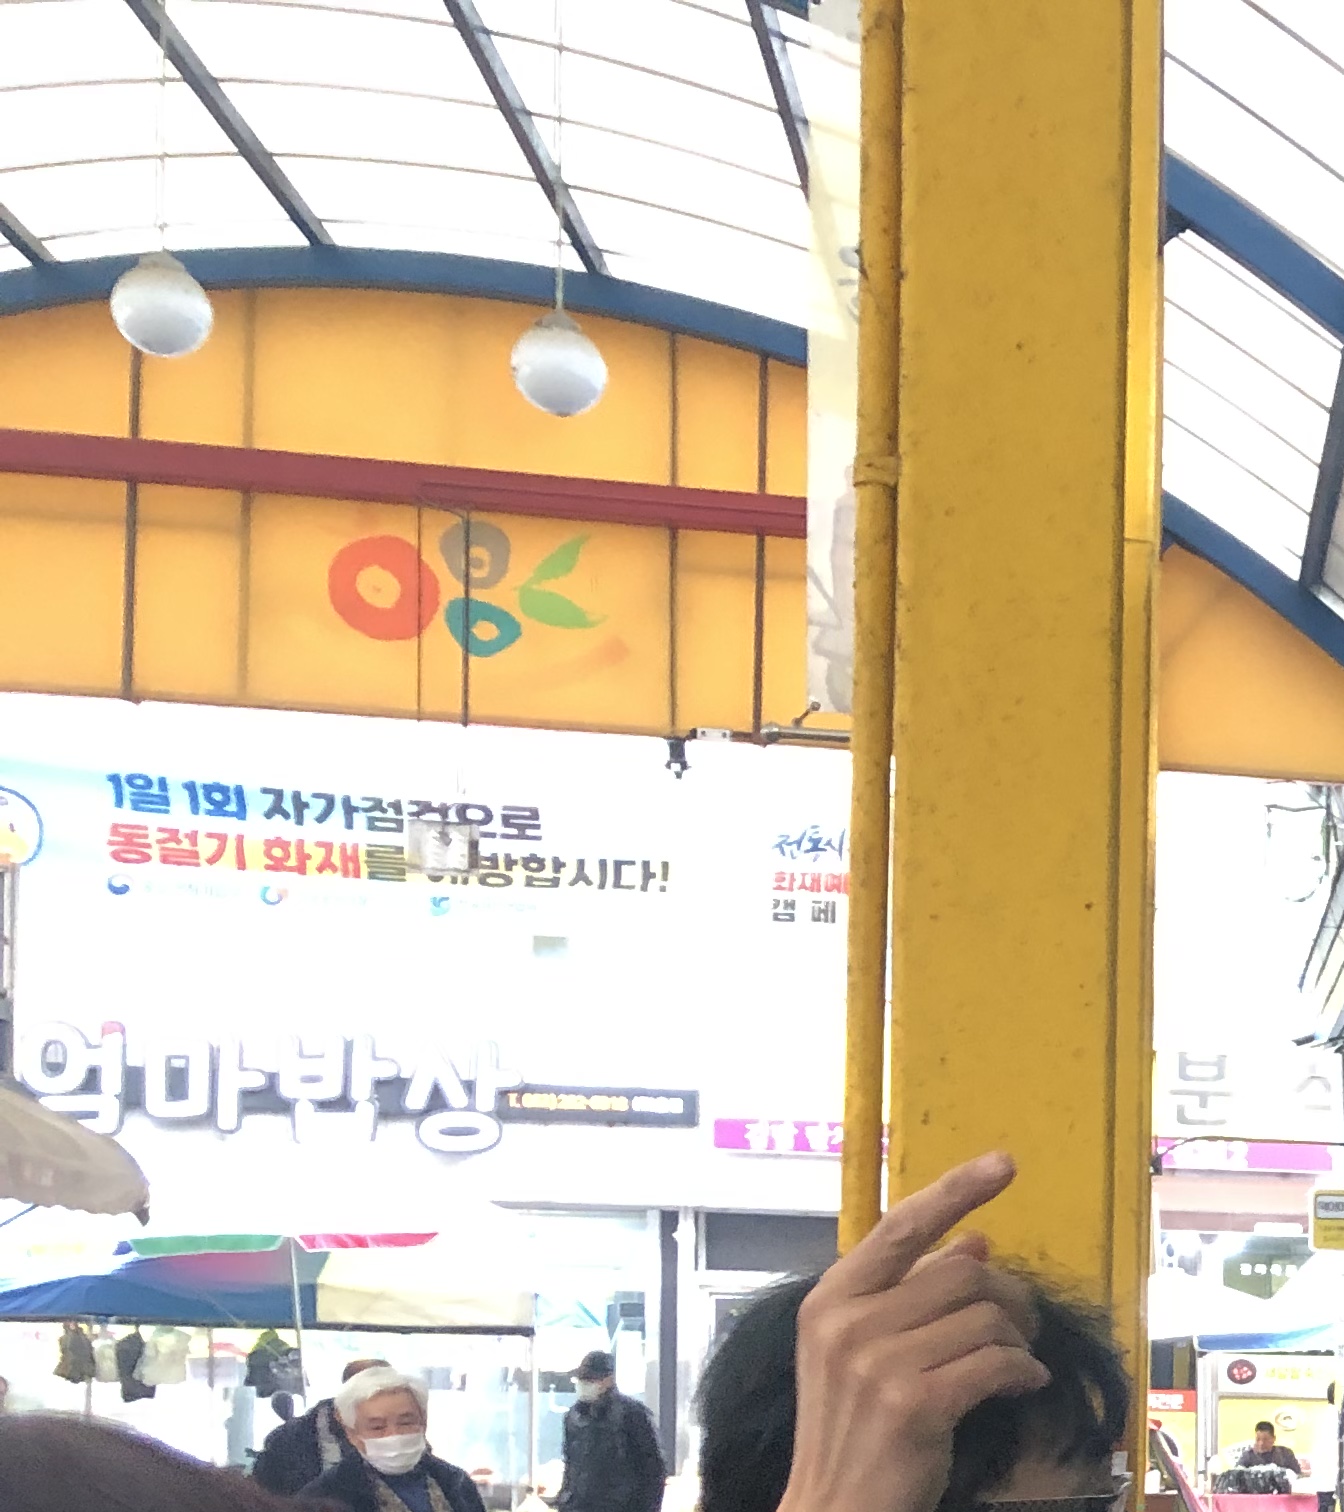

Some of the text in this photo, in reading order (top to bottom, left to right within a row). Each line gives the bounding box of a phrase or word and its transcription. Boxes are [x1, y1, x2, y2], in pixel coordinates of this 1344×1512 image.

[106, 772, 171, 814] 1일
[181, 780, 247, 821] 1회
[106, 822, 670, 893] 동절기 화재를 방합시다!
[771, 824, 846, 863] 전통시
[14, 1020, 524, 1153] 엄마밥상
